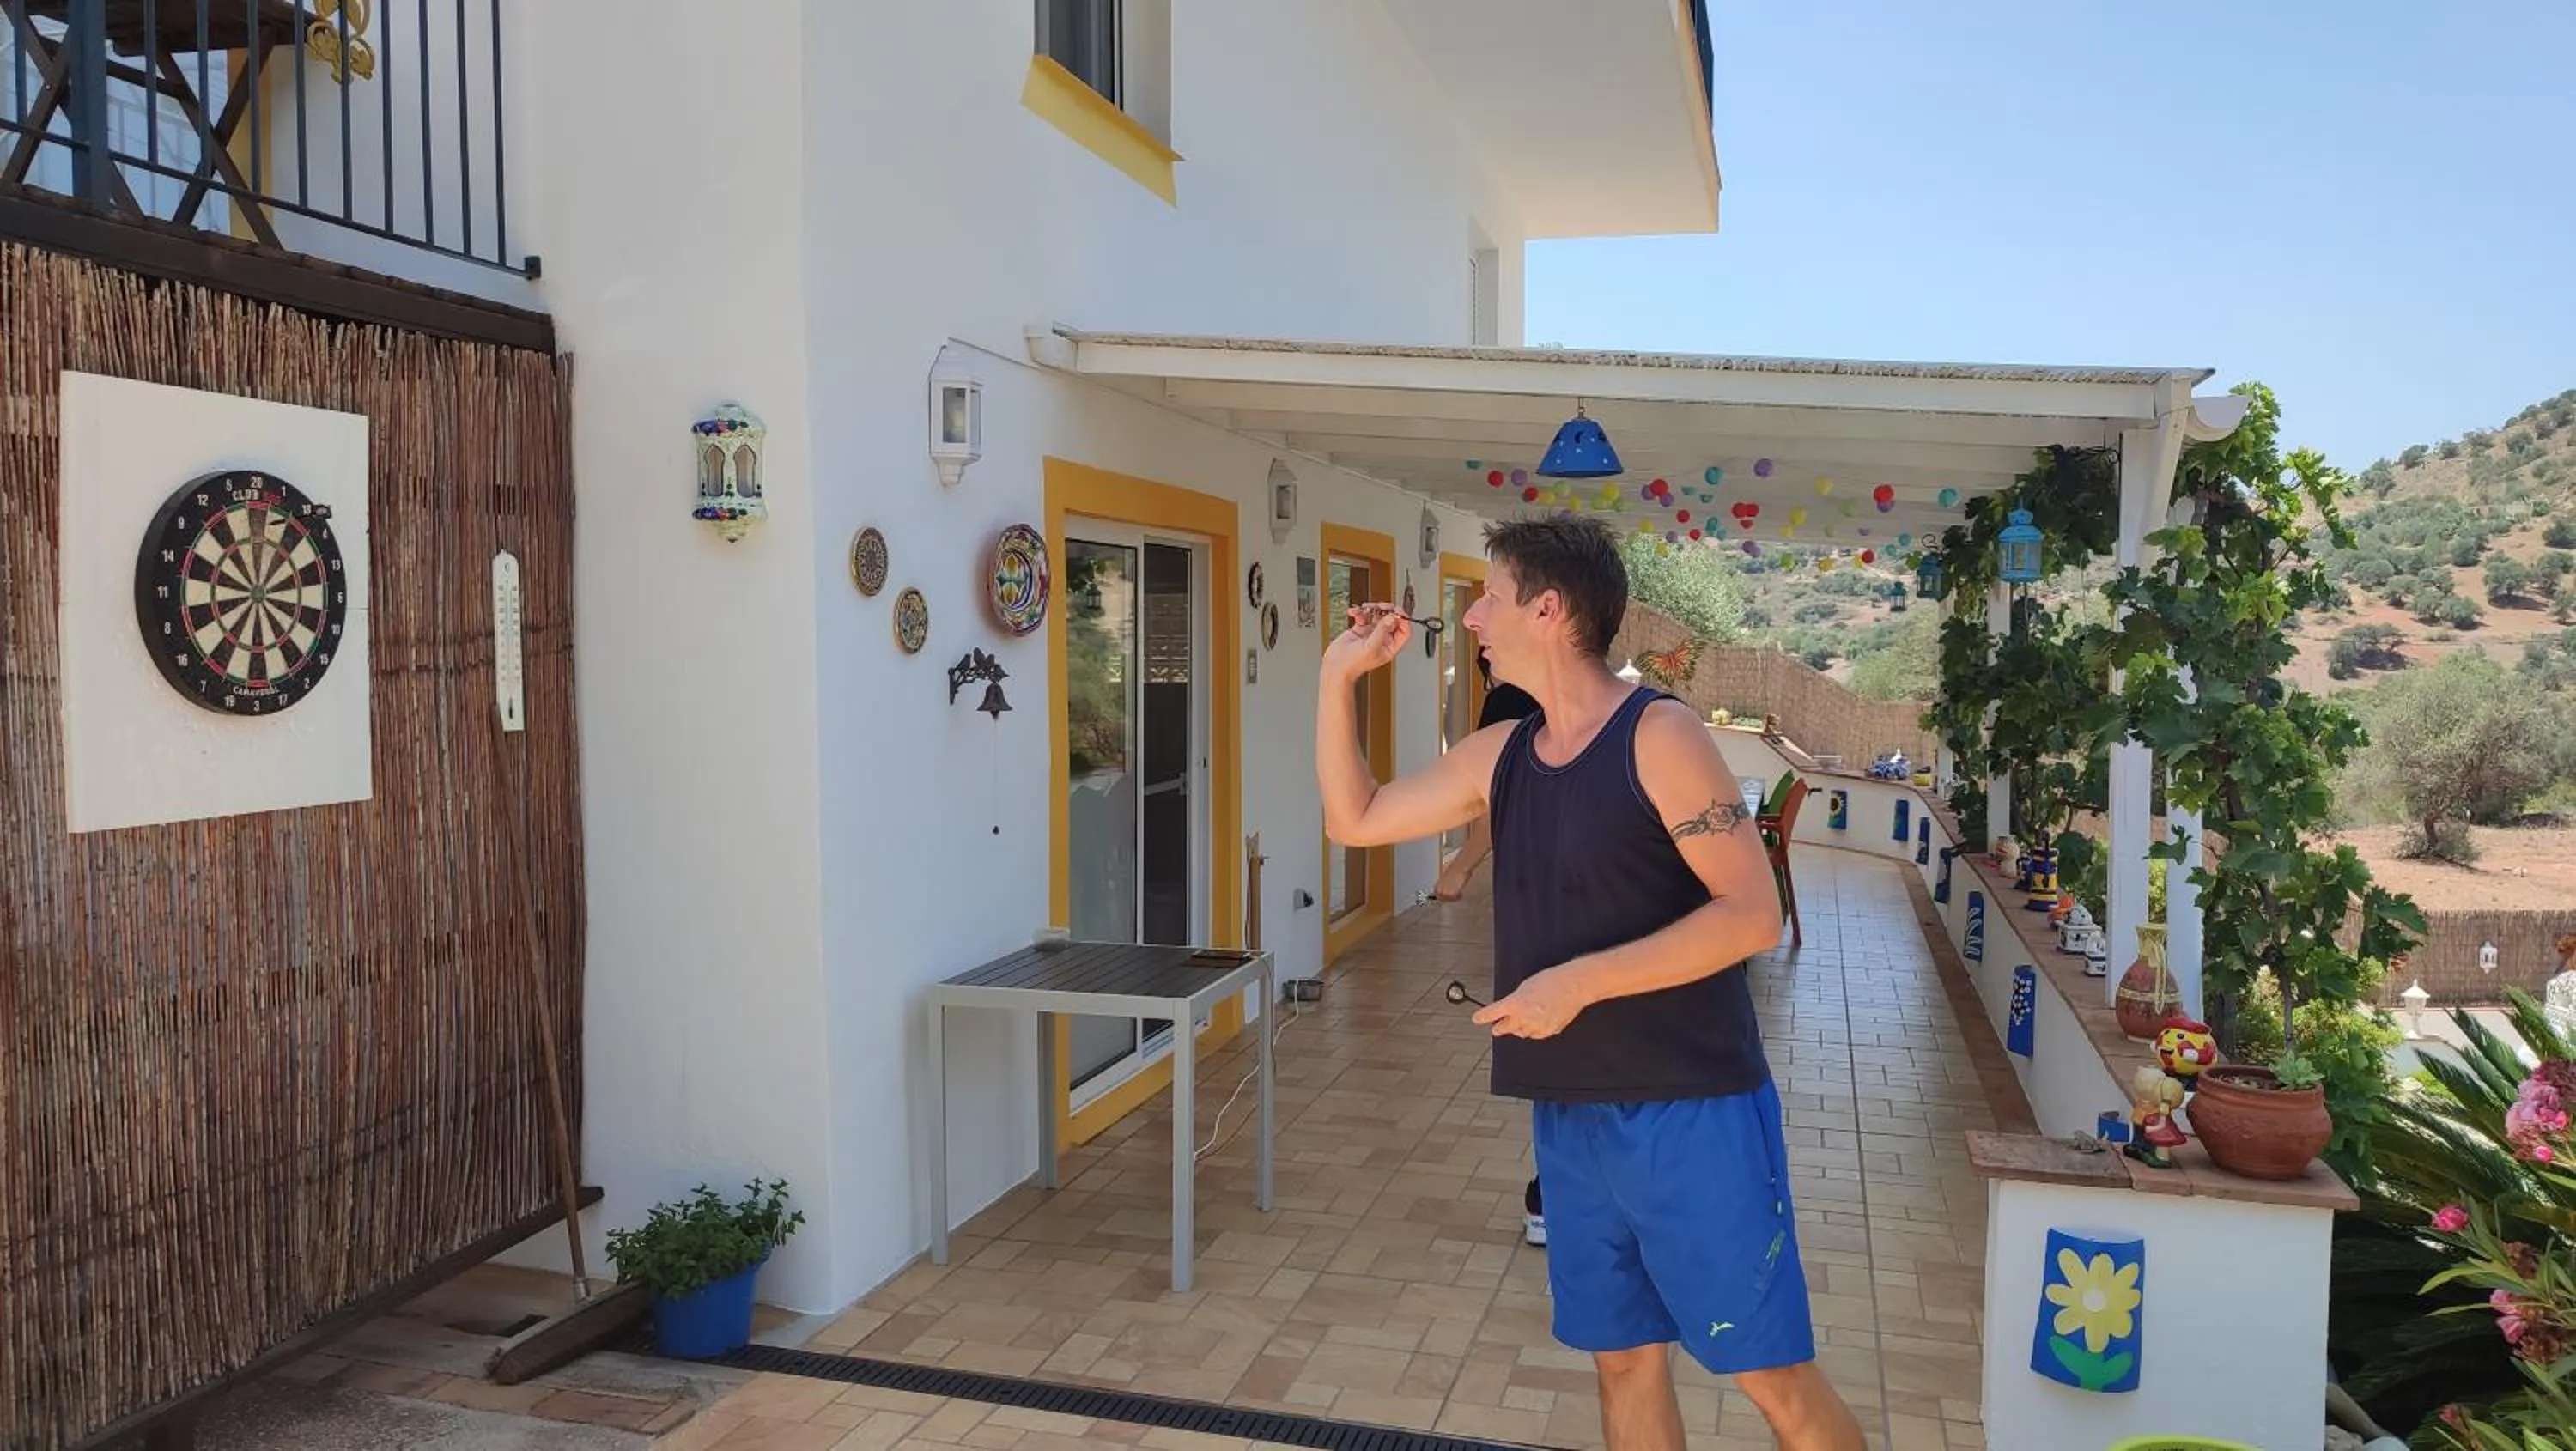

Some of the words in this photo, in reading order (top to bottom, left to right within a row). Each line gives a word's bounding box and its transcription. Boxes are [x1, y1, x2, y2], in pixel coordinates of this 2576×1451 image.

[250, 476, 264, 489] 20
[281, 485, 287, 497] 1
[197, 494, 209, 506] 12
[178, 516, 185, 530] 9
[161, 549, 174, 562] 14
[331, 559, 341, 571] 13
[157, 586, 169, 598] 11
[164, 622, 172, 634] 8
[331, 624, 341, 635] 10
[175, 653, 188, 666] 16
[200, 680, 207, 692] 7
[253, 700, 260, 712] 3
[277, 694, 288, 706] 17
